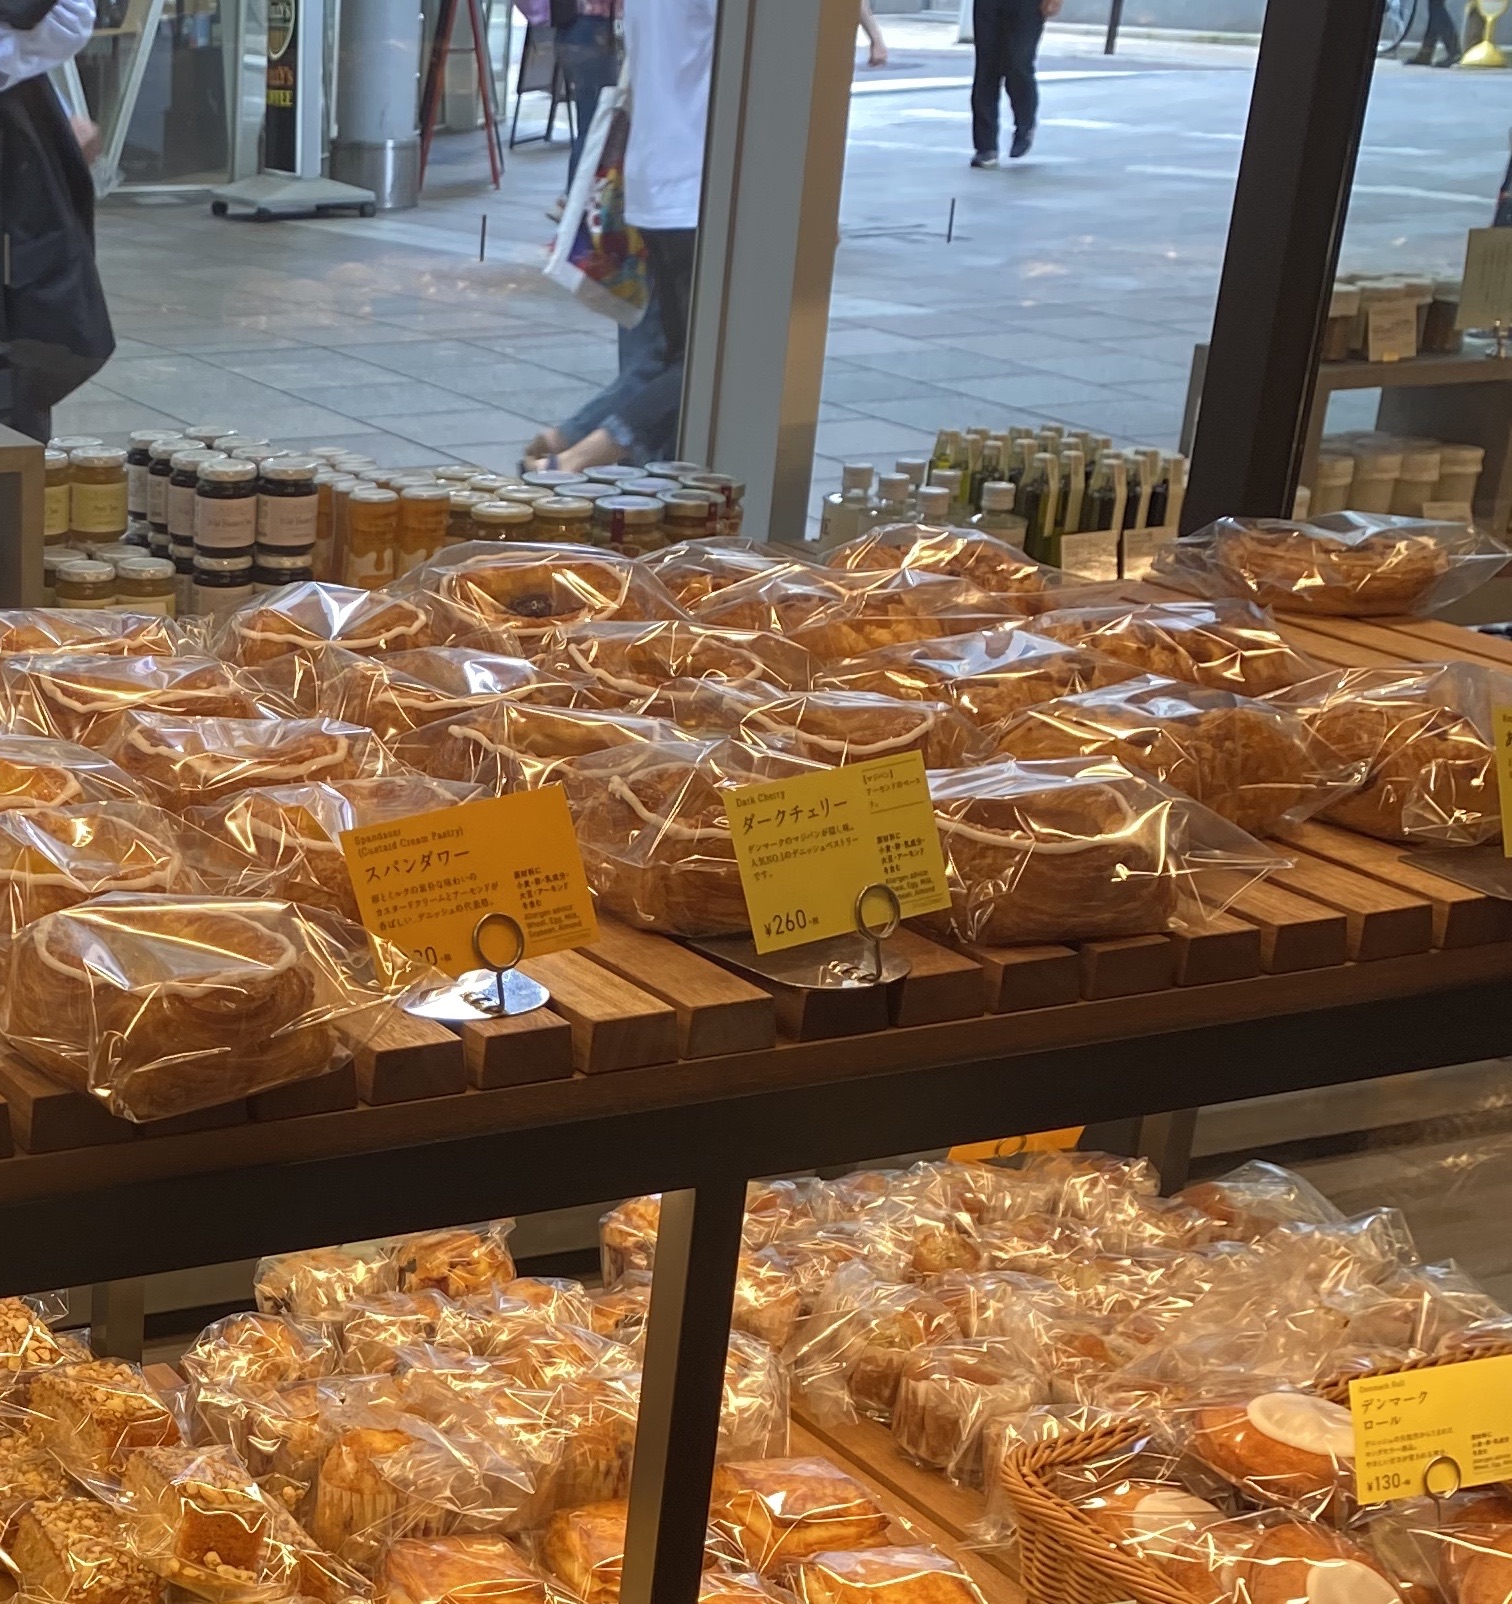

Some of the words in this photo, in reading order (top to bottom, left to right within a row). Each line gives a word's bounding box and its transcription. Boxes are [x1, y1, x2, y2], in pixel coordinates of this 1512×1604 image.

[741, 796, 848, 836] ダークチェリー
[363, 849, 471, 884] スパンダワー
[762, 908, 808, 937] ¥260
[1360, 1389, 1428, 1414] デンマーク
[1363, 1414, 1402, 1430] ロール
